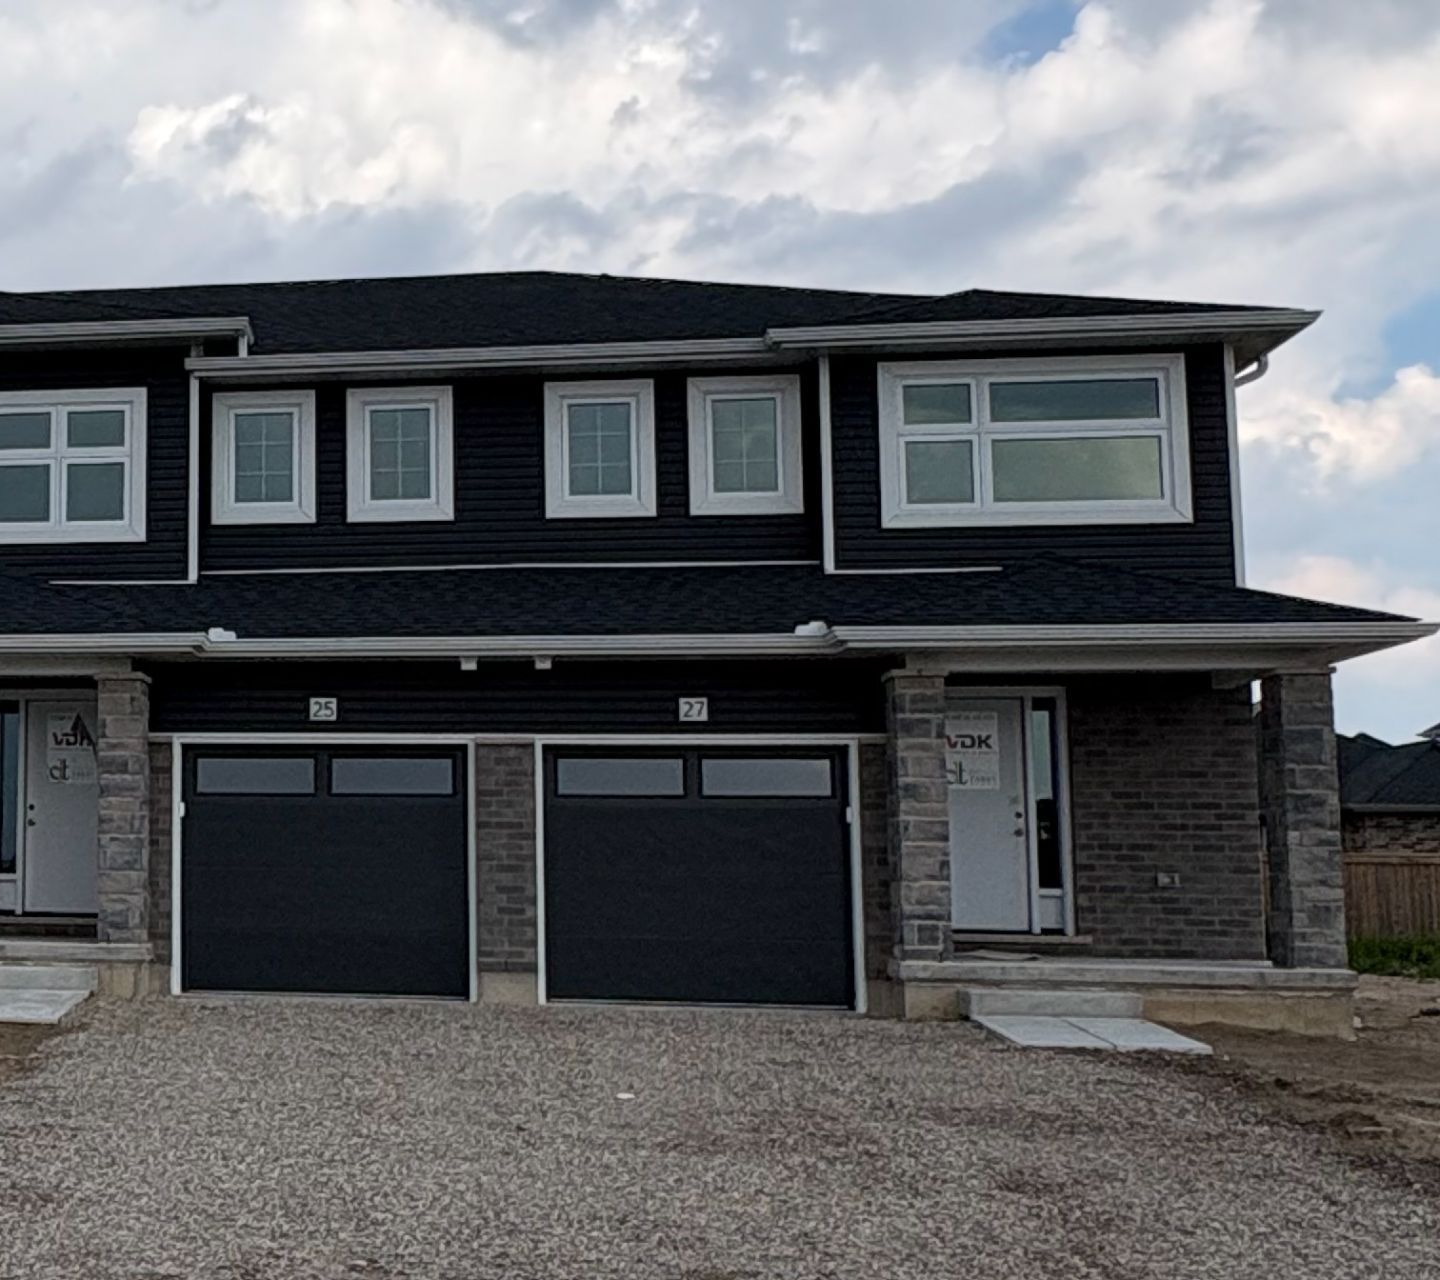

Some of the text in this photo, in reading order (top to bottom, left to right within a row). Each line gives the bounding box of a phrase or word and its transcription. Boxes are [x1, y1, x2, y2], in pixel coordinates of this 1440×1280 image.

[313, 701, 335, 717] 25
[683, 701, 704, 717] 27
[946, 734, 993, 749] VDK
